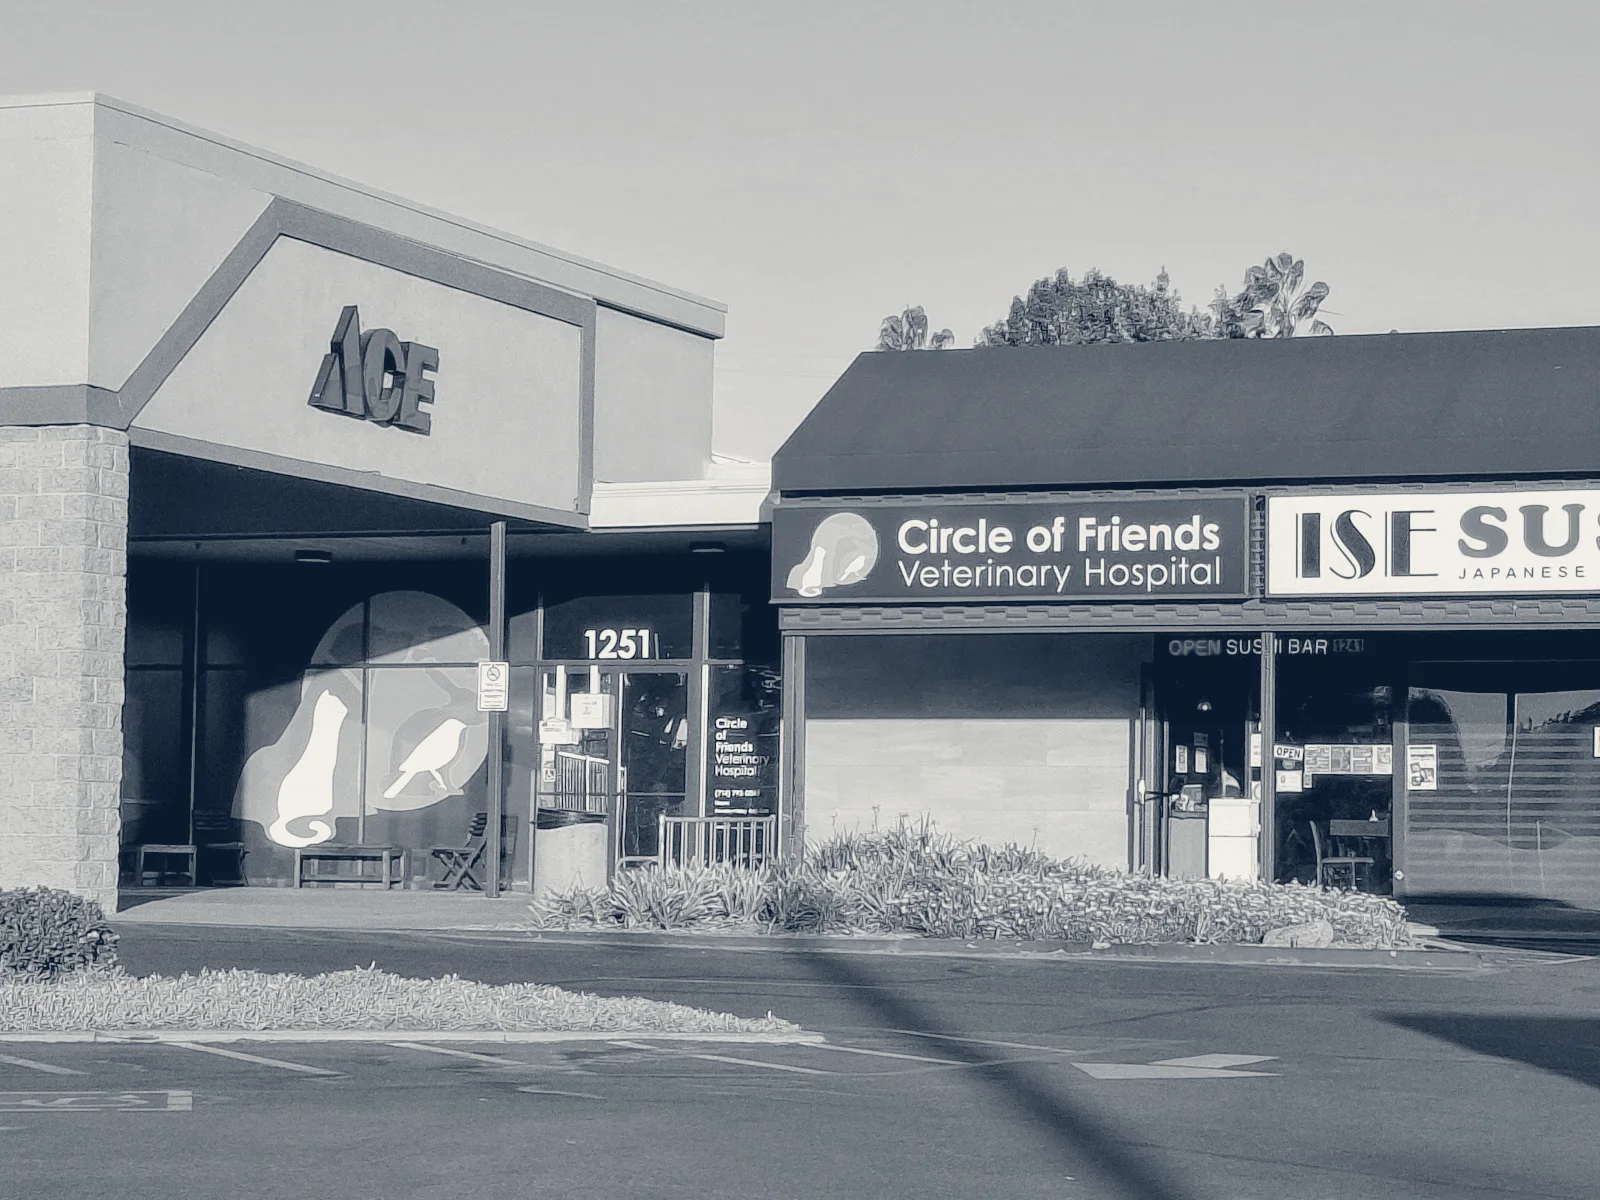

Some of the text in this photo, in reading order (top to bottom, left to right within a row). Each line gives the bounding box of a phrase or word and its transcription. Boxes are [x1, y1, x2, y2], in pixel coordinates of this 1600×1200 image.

[307, 305, 439, 436] ACE
[898, 515, 1220, 554] Circle of Friends
[1295, 510, 1439, 579] ISE
[898, 556, 1221, 593] Veterinary Hospital
[1458, 565, 1586, 580] JAPANESE
[584, 629, 650, 659] 1251
[1168, 639, 1221, 655] OPEN
[1288, 639, 1328, 655] BAR
[715, 718, 748, 729] Circle
[715, 730, 728, 741] of
[715, 741, 753, 753] Friends
[1276, 747, 1300, 758] OPEN
[715, 753, 770, 765] Veterinary
